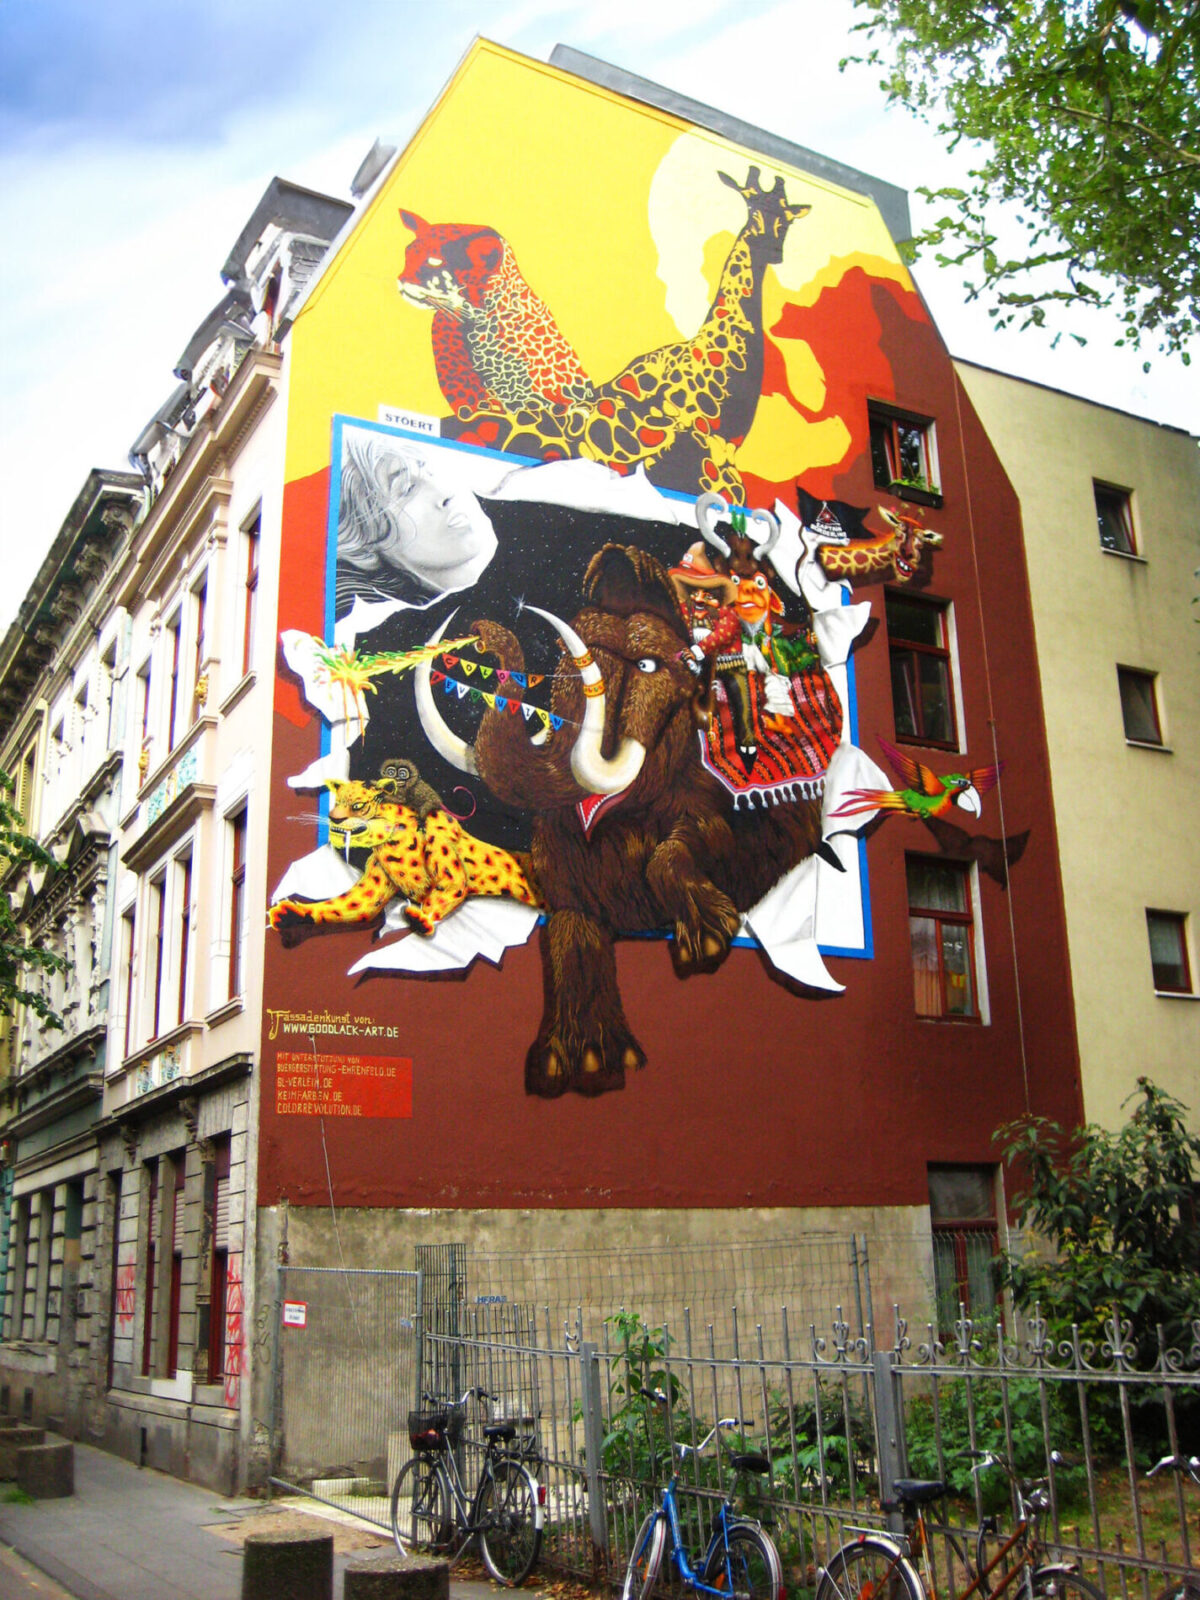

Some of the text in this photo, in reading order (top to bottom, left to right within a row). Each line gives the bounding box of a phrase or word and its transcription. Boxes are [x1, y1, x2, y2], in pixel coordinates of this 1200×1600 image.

[385, 413, 433, 431] STOERT
[445, 655, 541, 685] COLOUR
[432, 673, 563, 728] REVOLUTION
[277, 1052, 289, 1061] MIT
